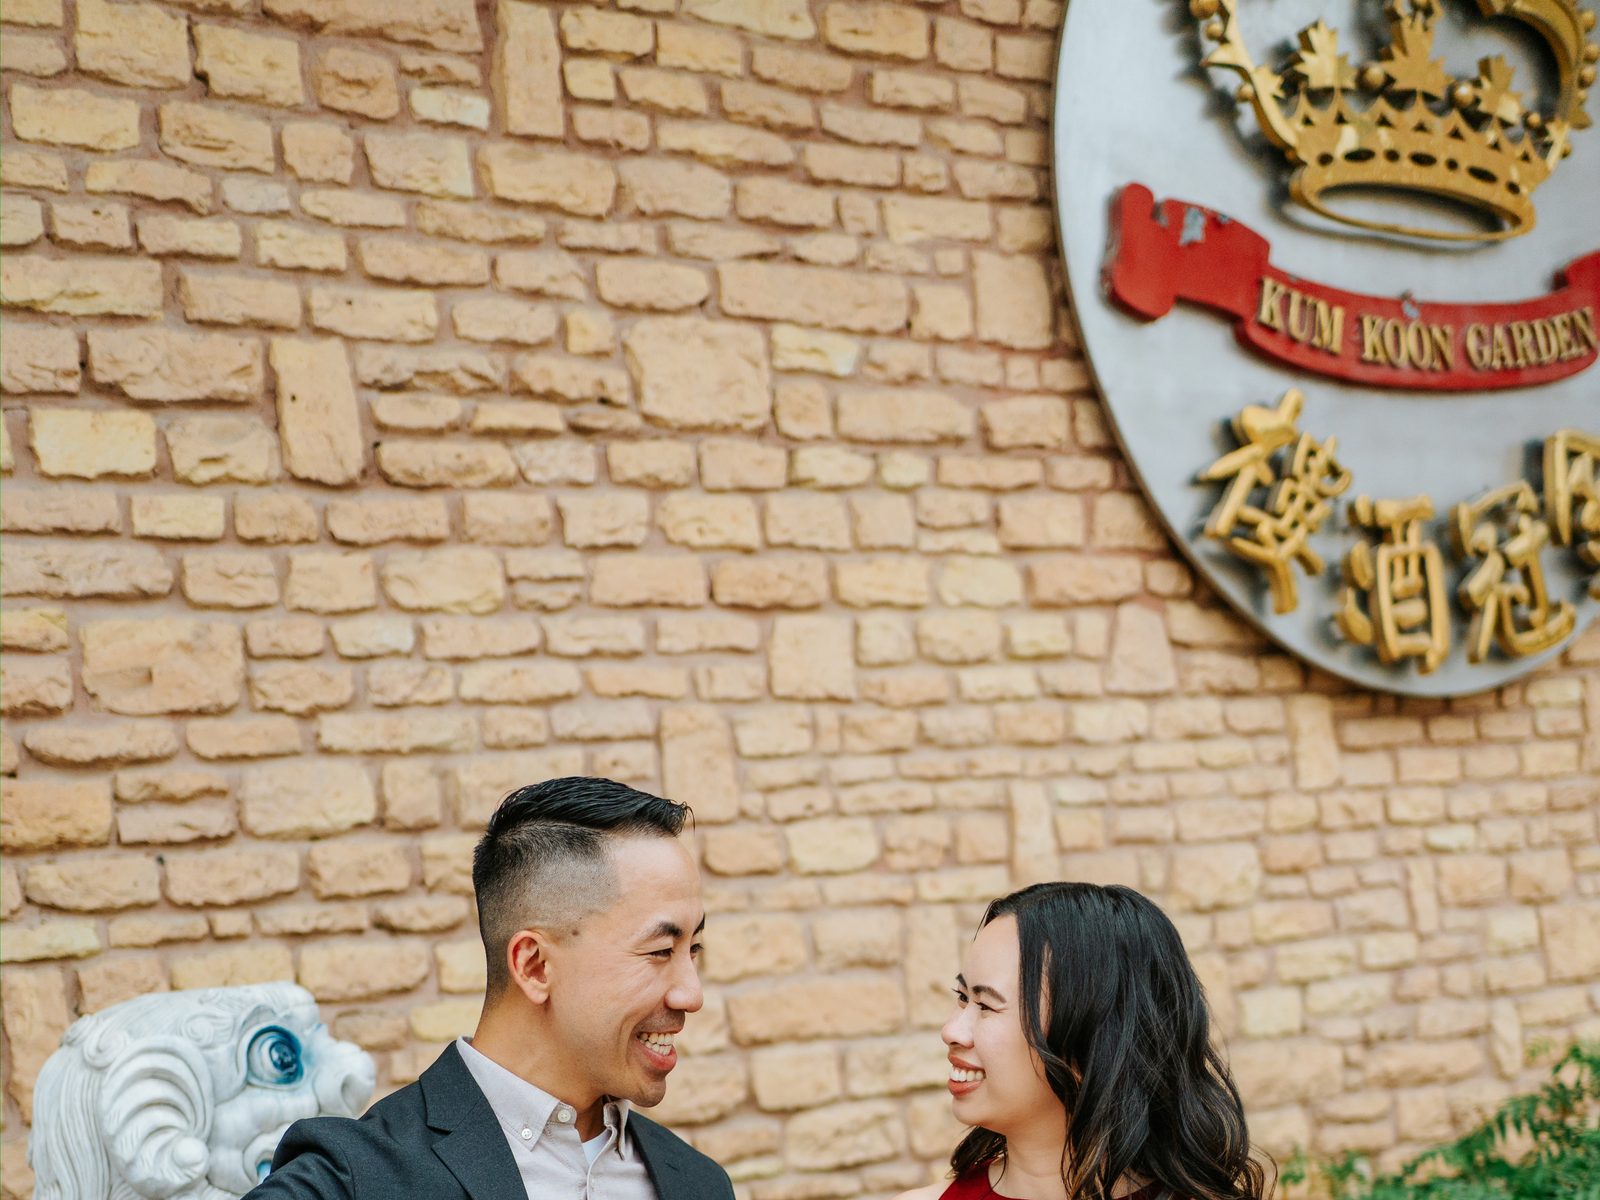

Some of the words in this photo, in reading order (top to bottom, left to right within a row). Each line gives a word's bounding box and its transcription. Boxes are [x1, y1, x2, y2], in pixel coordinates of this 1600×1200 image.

[1258, 276, 1345, 356] KUM
[1359, 312, 1453, 371] KOON
[1465, 306, 1598, 371] GARDEN
